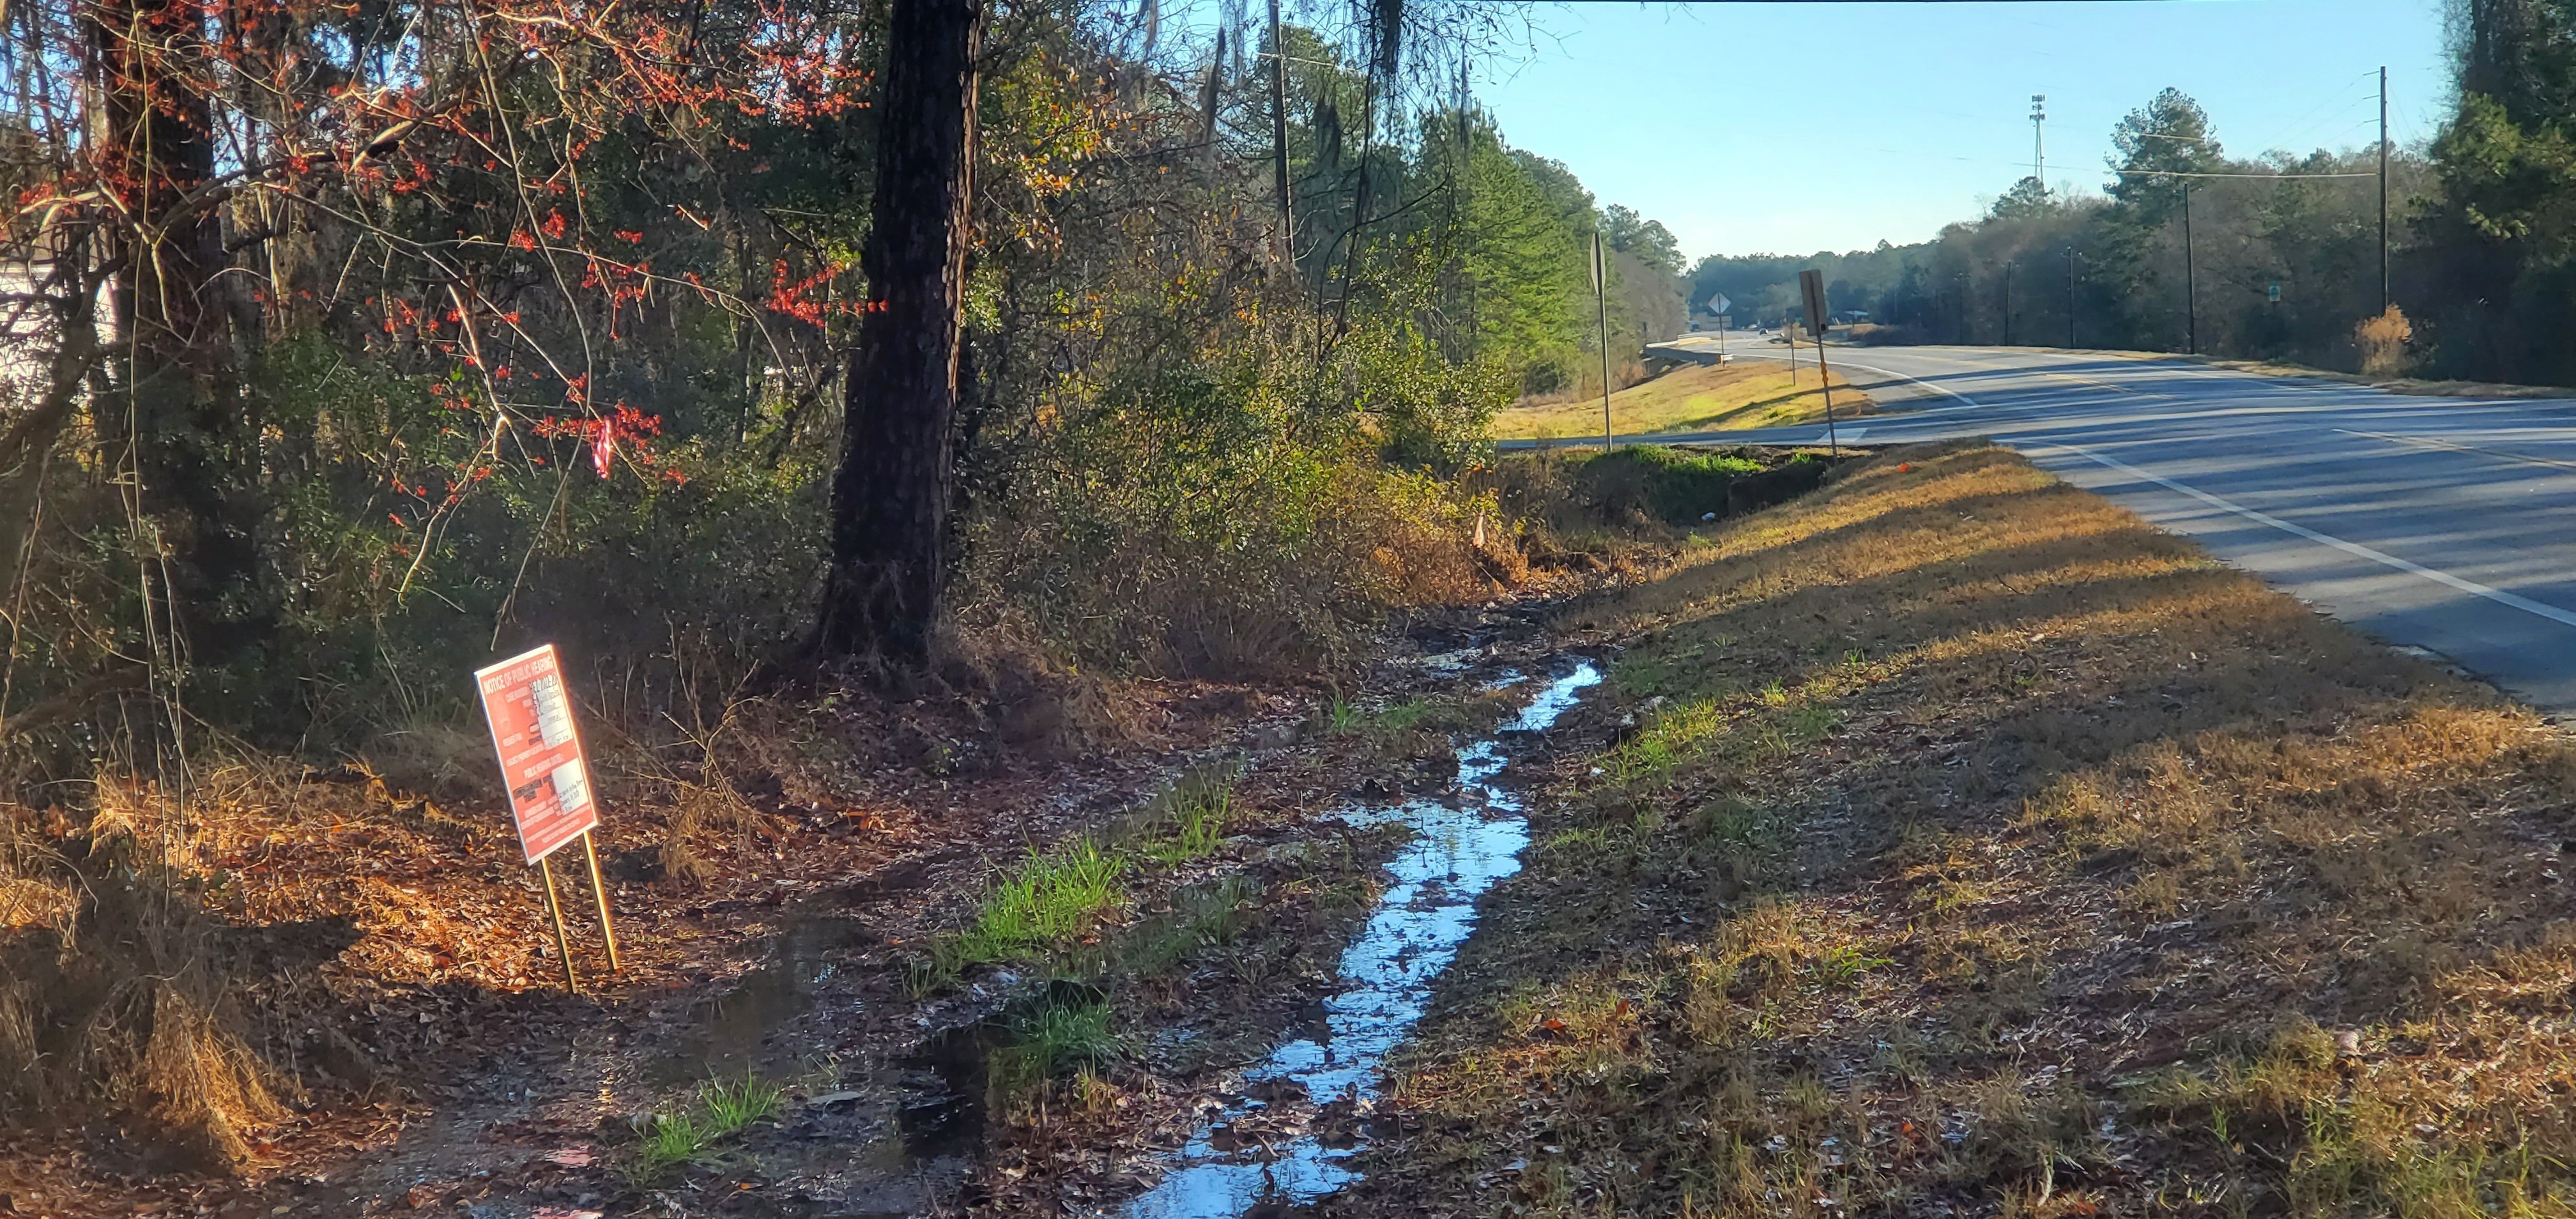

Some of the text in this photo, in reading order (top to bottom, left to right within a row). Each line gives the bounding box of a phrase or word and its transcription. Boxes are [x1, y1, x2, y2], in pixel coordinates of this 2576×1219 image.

[484, 675, 505, 694] NOTICE
[503, 671, 513, 686] OF
[511, 664, 531, 683] PUBLIC
[530, 656, 553, 675] HEARING
